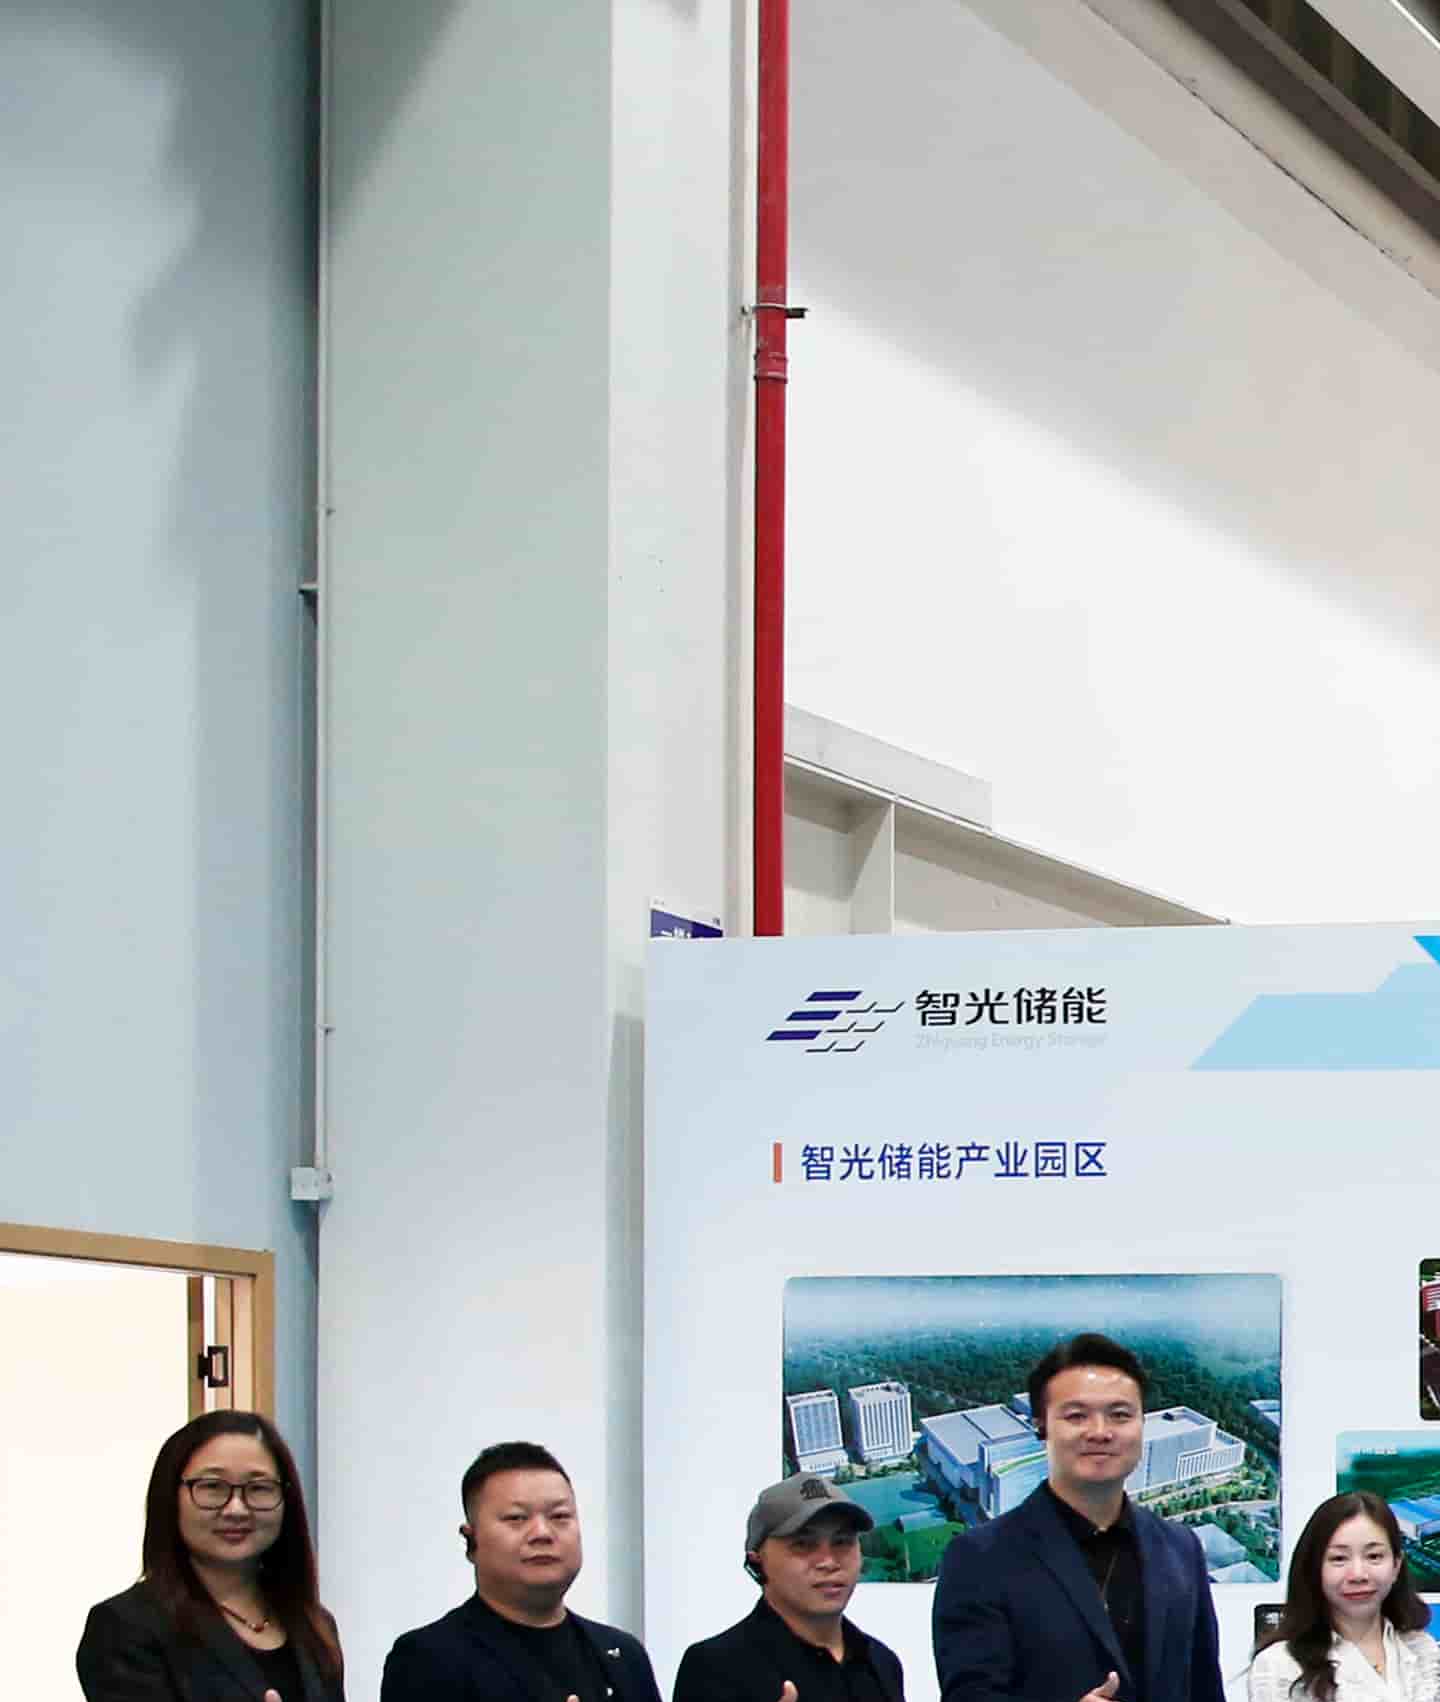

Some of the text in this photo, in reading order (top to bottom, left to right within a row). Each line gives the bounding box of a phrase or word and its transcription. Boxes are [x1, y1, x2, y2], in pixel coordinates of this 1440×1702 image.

[914, 986, 1108, 1027] 智光储能
[801, 1142, 1107, 1180] 智光储能产业园区
